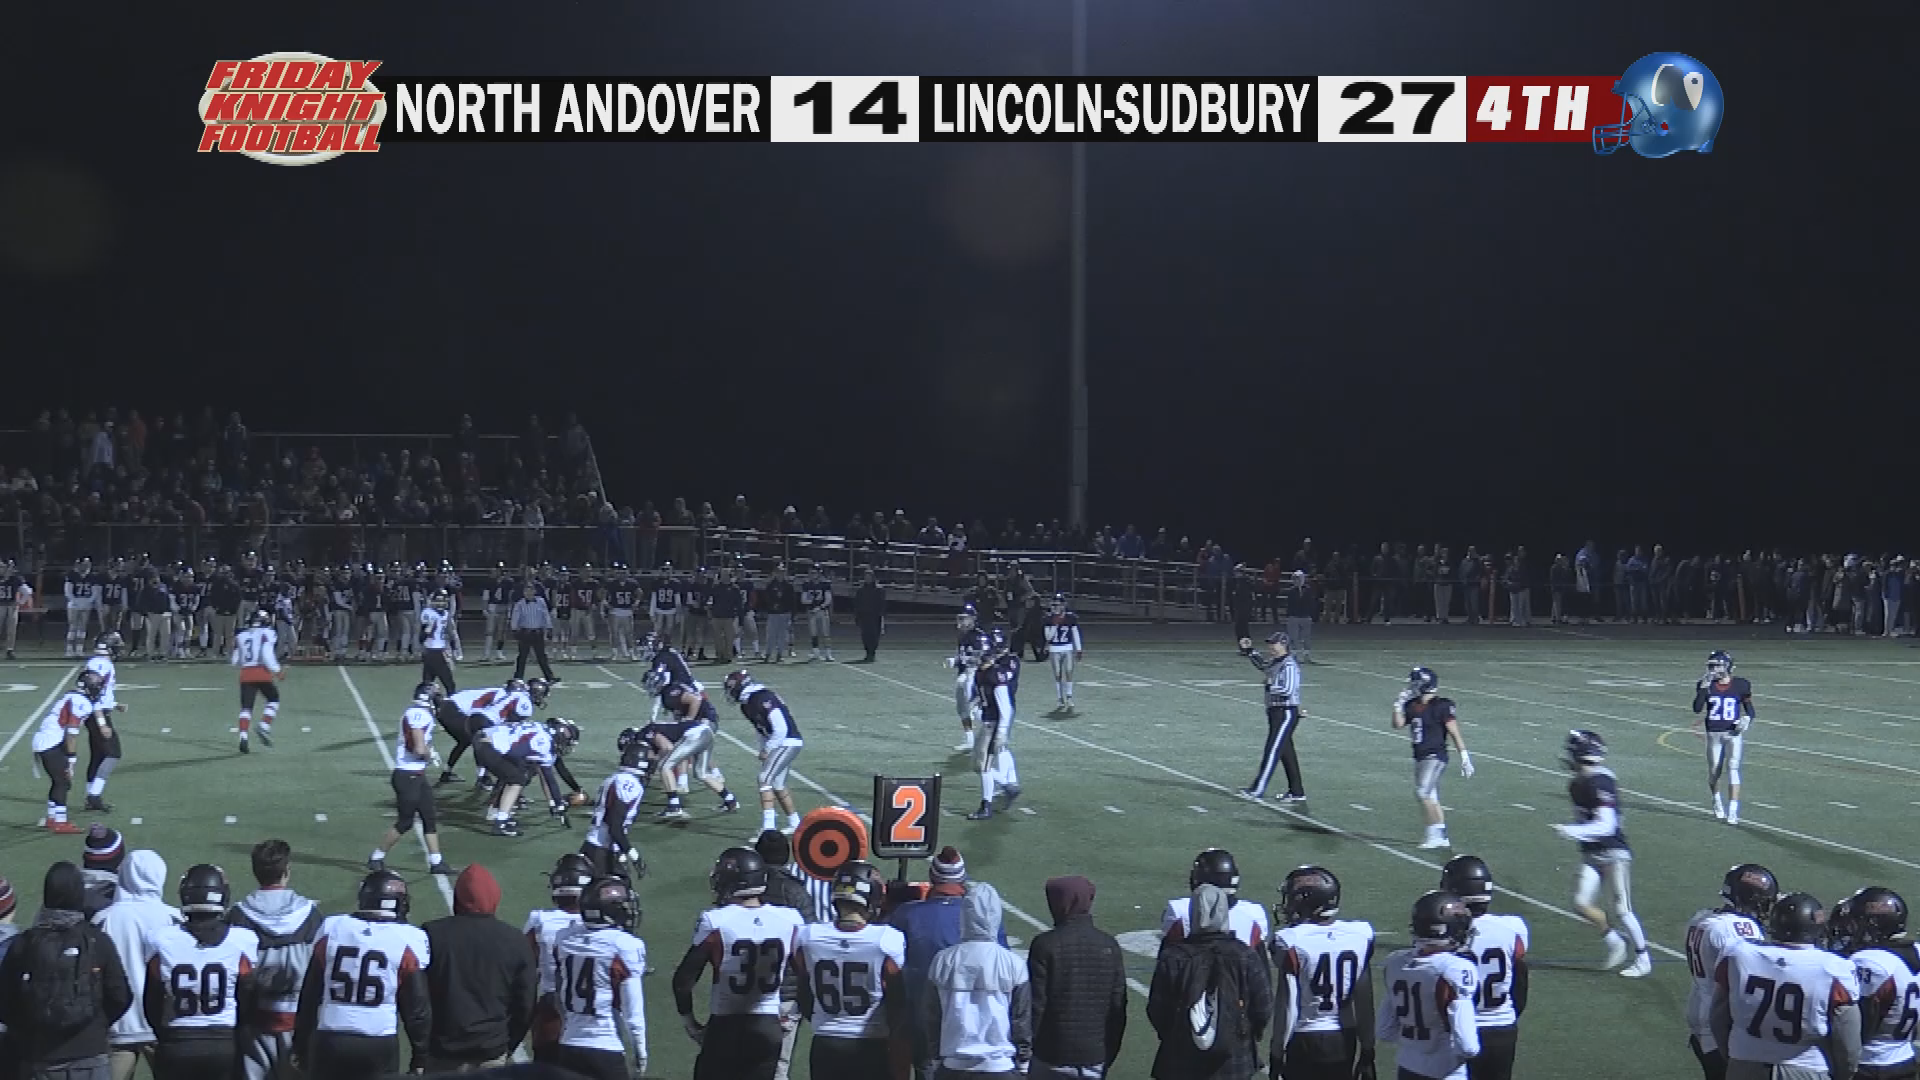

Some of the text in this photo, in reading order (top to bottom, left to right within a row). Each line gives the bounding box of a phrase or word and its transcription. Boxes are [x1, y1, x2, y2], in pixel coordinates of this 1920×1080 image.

[244, 638, 253, 663] 3
[1707, 697, 1736, 721] 28
[889, 785, 926, 843] 2
[171, 963, 228, 1017] 60
[330, 946, 388, 1006] 56
[565, 955, 597, 1015] 14
[729, 938, 785, 995] 33
[814, 959, 872, 1016] 65
[1310, 950, 1359, 1011] 40
[1461, 969, 1474, 986] 21
[1393, 979, 1431, 1040] 21
[1744, 974, 1805, 1044] 79
[1891, 982, 1920, 1041] 6
